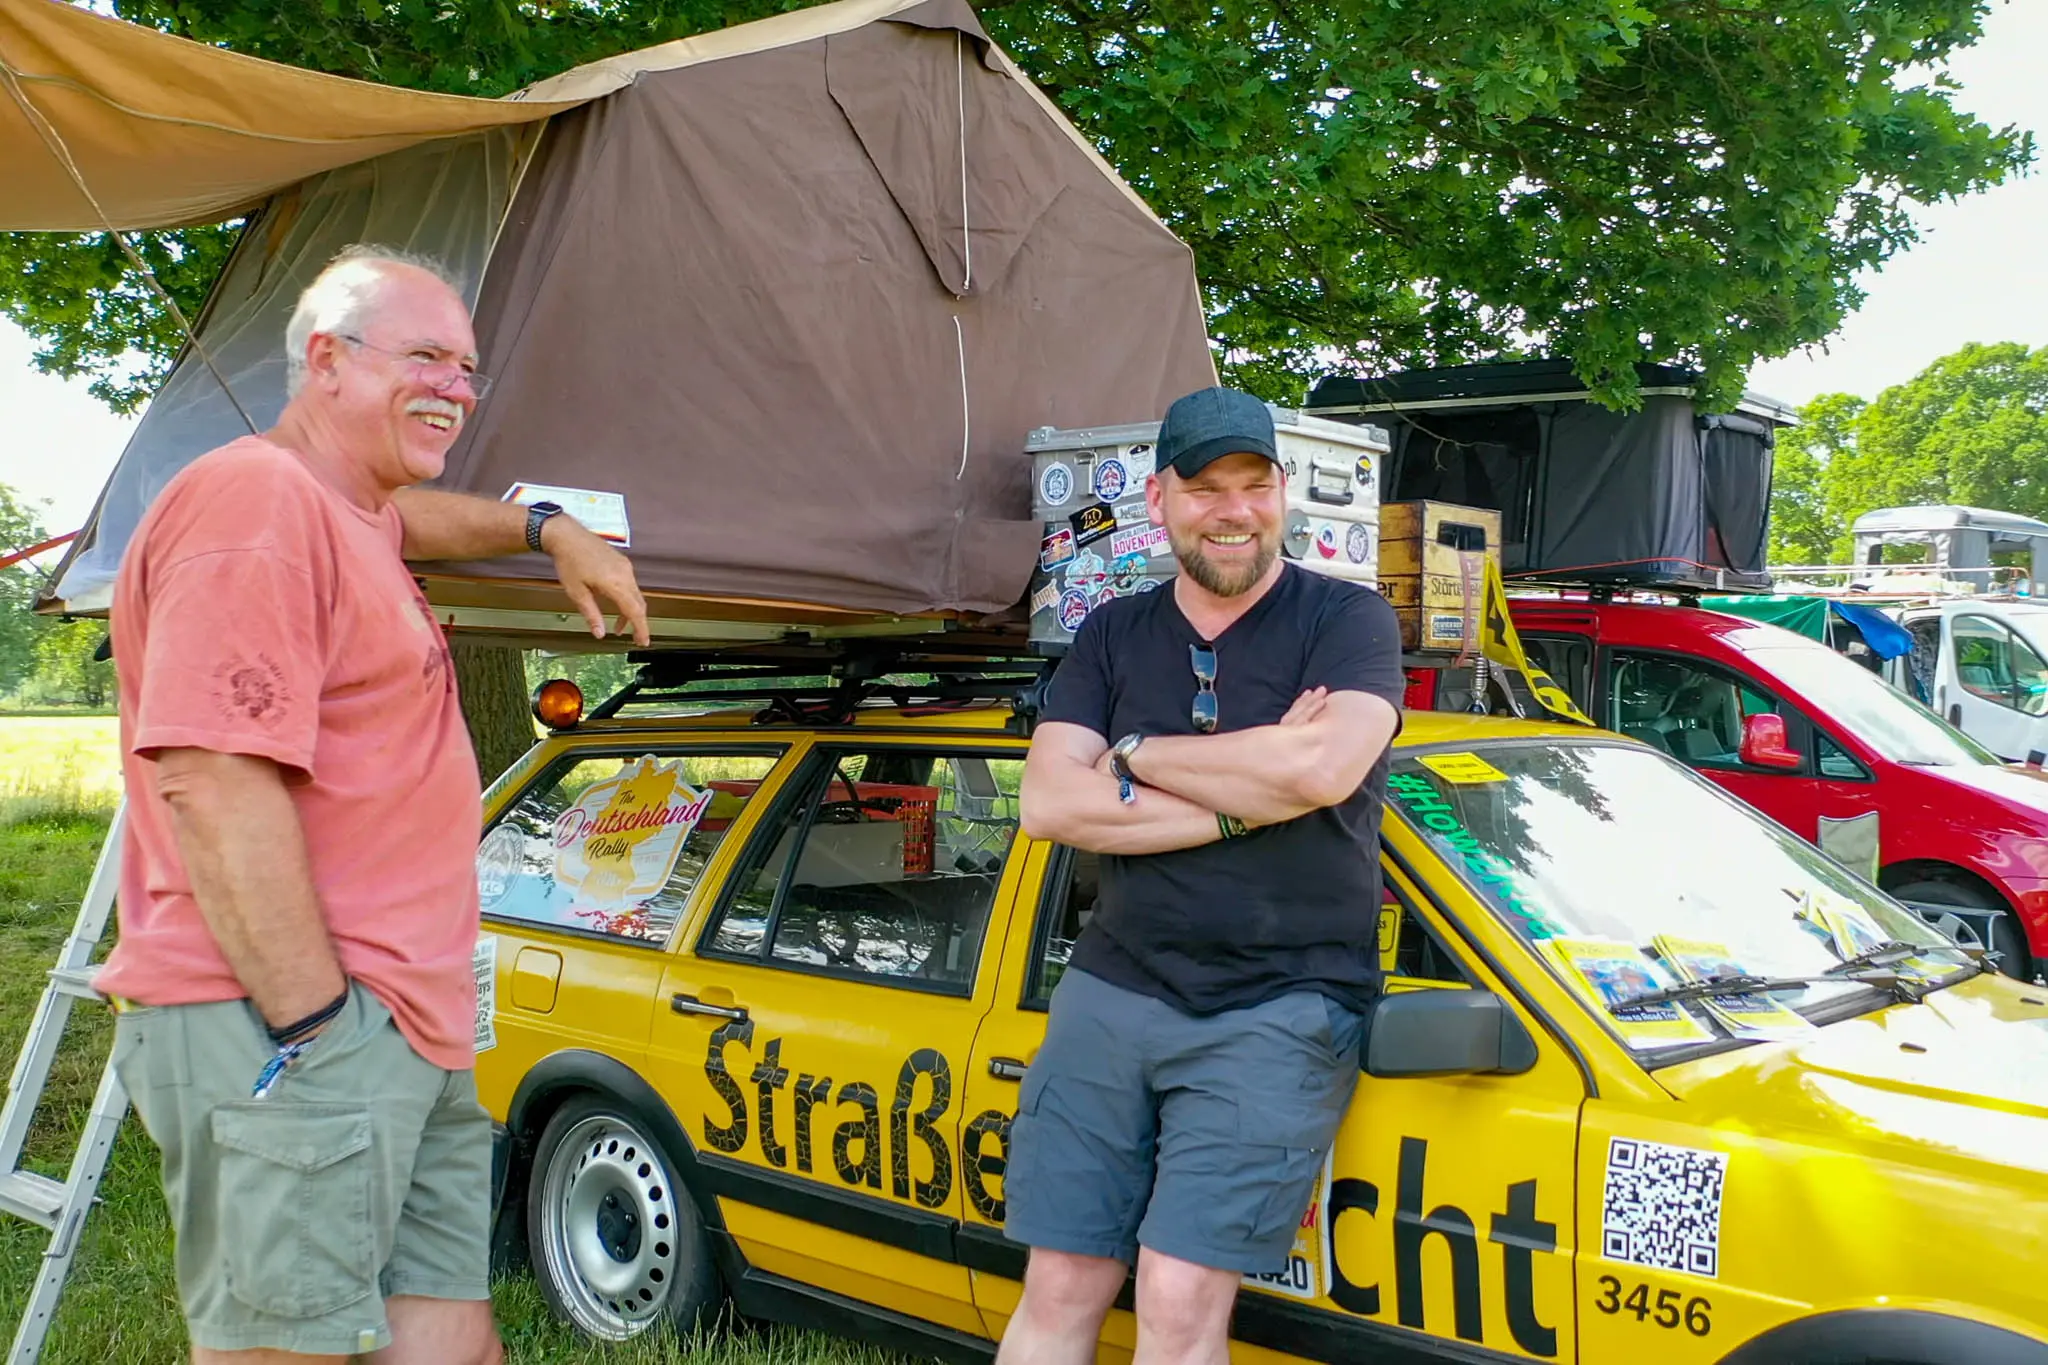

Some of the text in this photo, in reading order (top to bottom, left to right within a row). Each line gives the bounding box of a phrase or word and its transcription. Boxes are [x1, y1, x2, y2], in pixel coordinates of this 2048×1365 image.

[1113, 527, 1168, 556] ADVENTURE
[619, 789, 635, 806] The
[557, 794, 709, 849] Deutschland
[588, 837, 629, 862] Rally
[1641, 1010, 1660, 1021] Road
[1594, 1274, 1712, 1338] 3456
